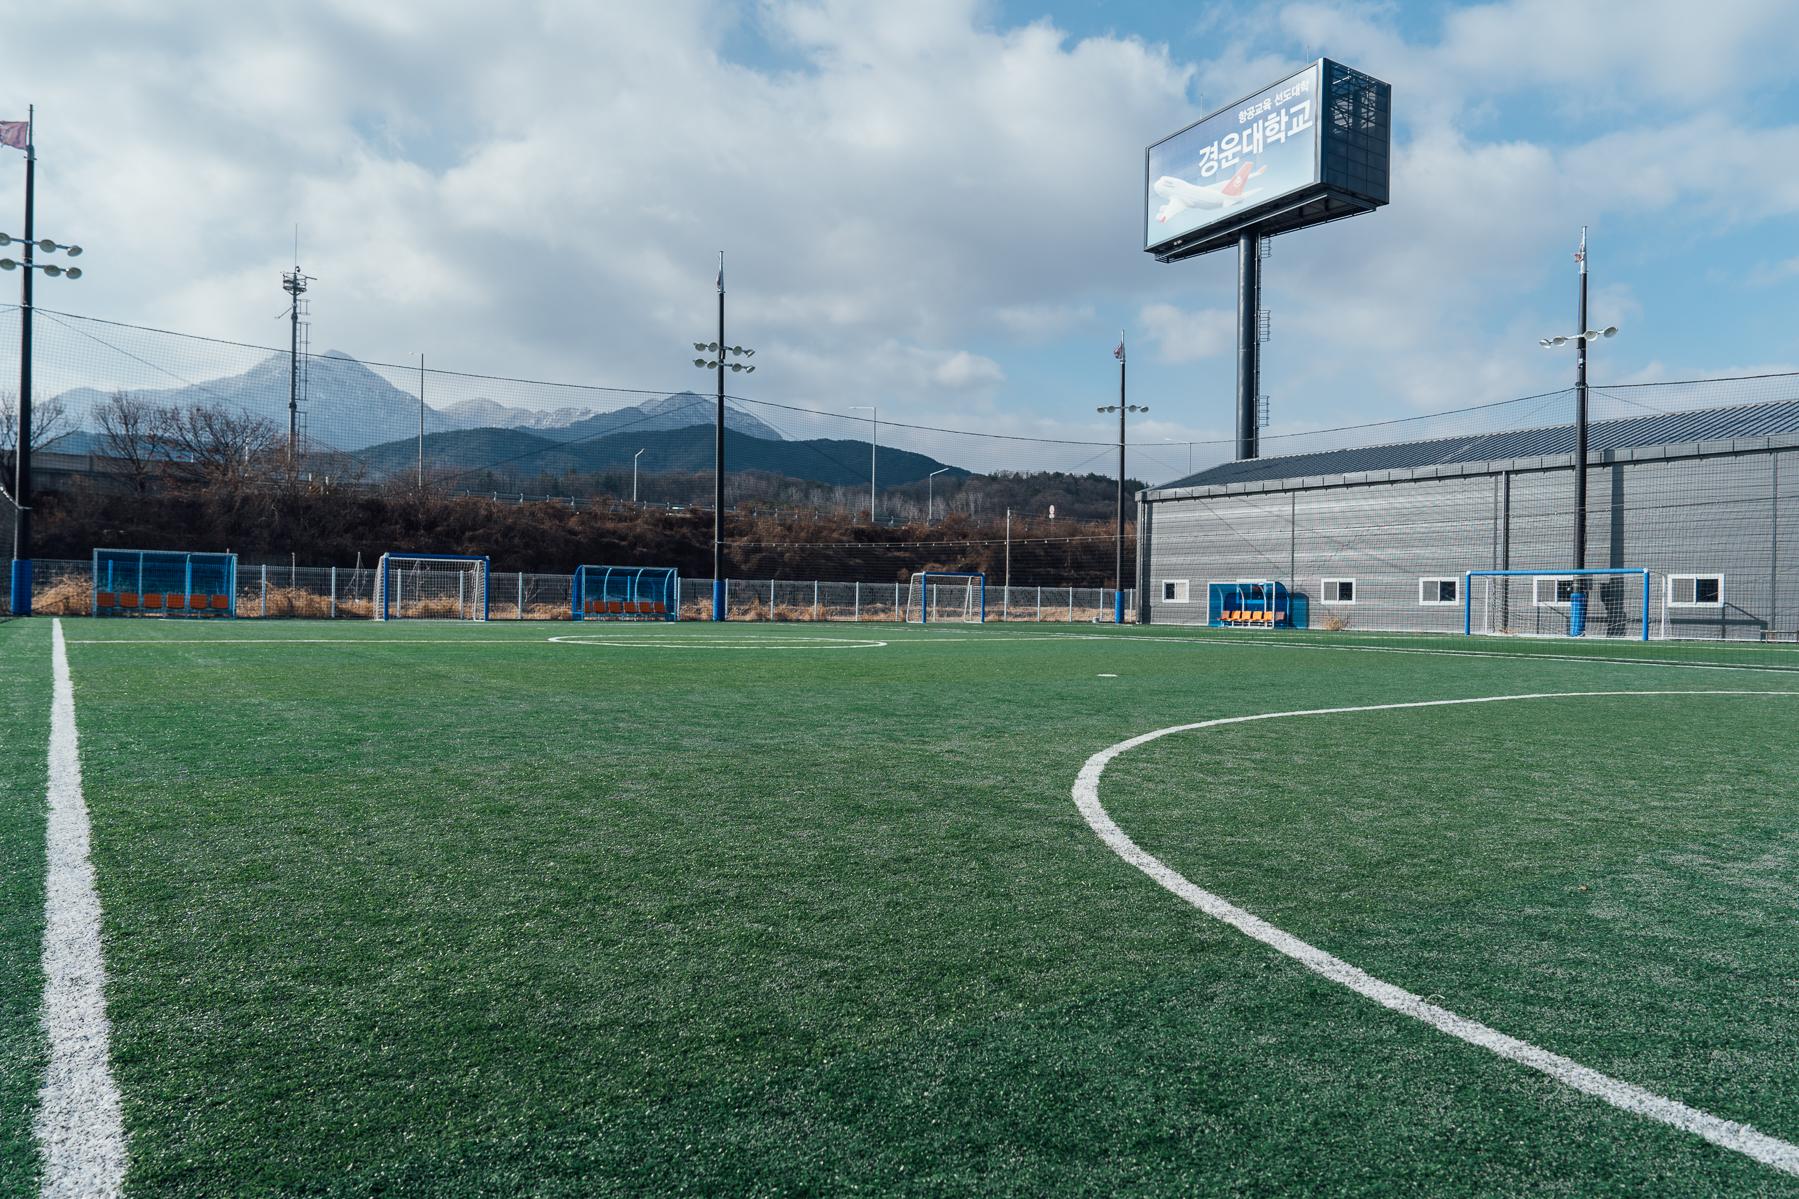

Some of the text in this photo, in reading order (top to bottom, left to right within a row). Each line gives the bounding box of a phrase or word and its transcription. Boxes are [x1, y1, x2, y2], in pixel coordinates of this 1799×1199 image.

[1238, 80, 1309, 124] 항공교육 선도대학
[1200, 100, 1313, 177] 경운대학교
